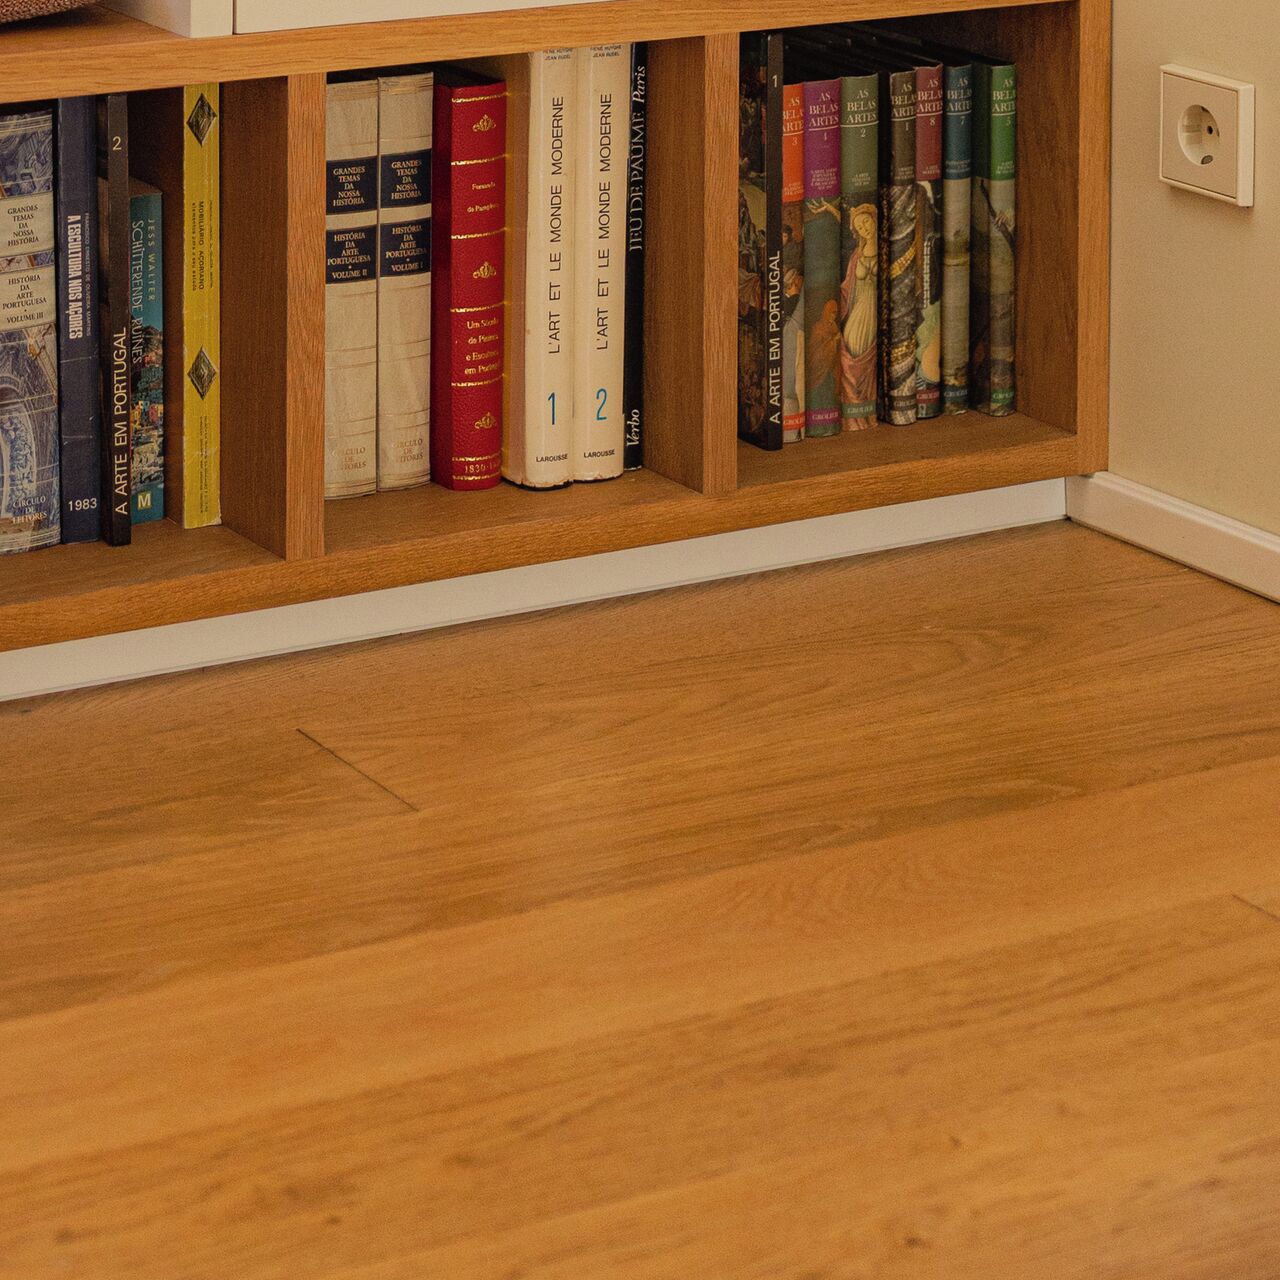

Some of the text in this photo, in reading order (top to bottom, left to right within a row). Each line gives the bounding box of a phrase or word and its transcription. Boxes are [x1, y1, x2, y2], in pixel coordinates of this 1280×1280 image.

[632, 66, 646, 104] Paris
[809, 102, 839, 115] BELAS
[808, 114, 839, 127] ARTES
[112, 136, 122, 150] 2
[8, 205, 38, 215] GRANDES
[13, 214, 34, 222] TEMAS
[548, 96, 564, 354] L'ART ET LE MONDE MODERNE
[13, 230, 34, 238] NOSSA
[8, 236, 39, 247] HISTÓRIA
[68, 224, 82, 278] ESCULTURA
[148, 219, 157, 301] JESS WALTER
[68, 279, 82, 300] NOS
[2, 298, 47, 310] PORTUGUESA
[7, 312, 45, 325] VOLUME III
[66, 302, 82, 339] AÇORES
[548, 392, 556, 425] 1
[596, 388, 607, 421] 2
[114, 327, 128, 516] A ARTE EM PORTUGAL
[626, 409, 640, 448] Verbo
[536, 454, 568, 463] LAROUSSE
[584, 449, 615, 459] LAROUSSE
[68, 498, 97, 511] 1983
